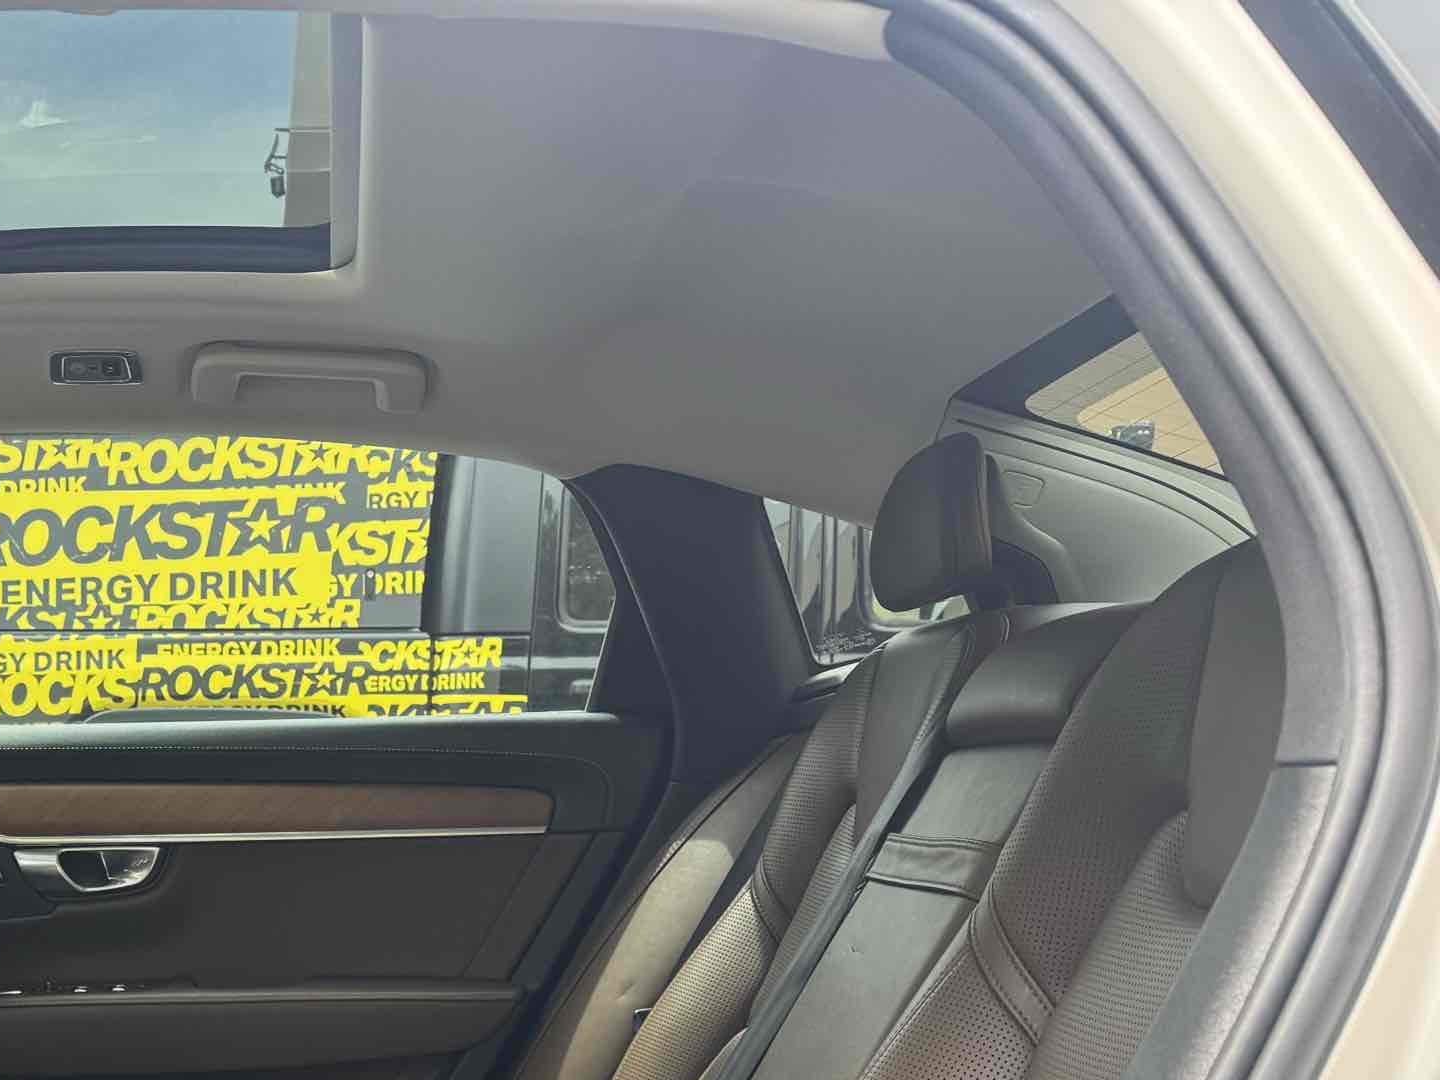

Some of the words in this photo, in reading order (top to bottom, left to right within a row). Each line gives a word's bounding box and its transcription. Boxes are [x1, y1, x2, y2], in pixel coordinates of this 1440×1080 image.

[1, 573, 160, 605] ENERGY
[169, 567, 298, 600] DRINK
[34, 648, 126, 672] DRINK
[157, 640, 257, 656] ENERGY
[260, 638, 341, 656] DRINK
[141, 661, 368, 701] ROCKSTAR
